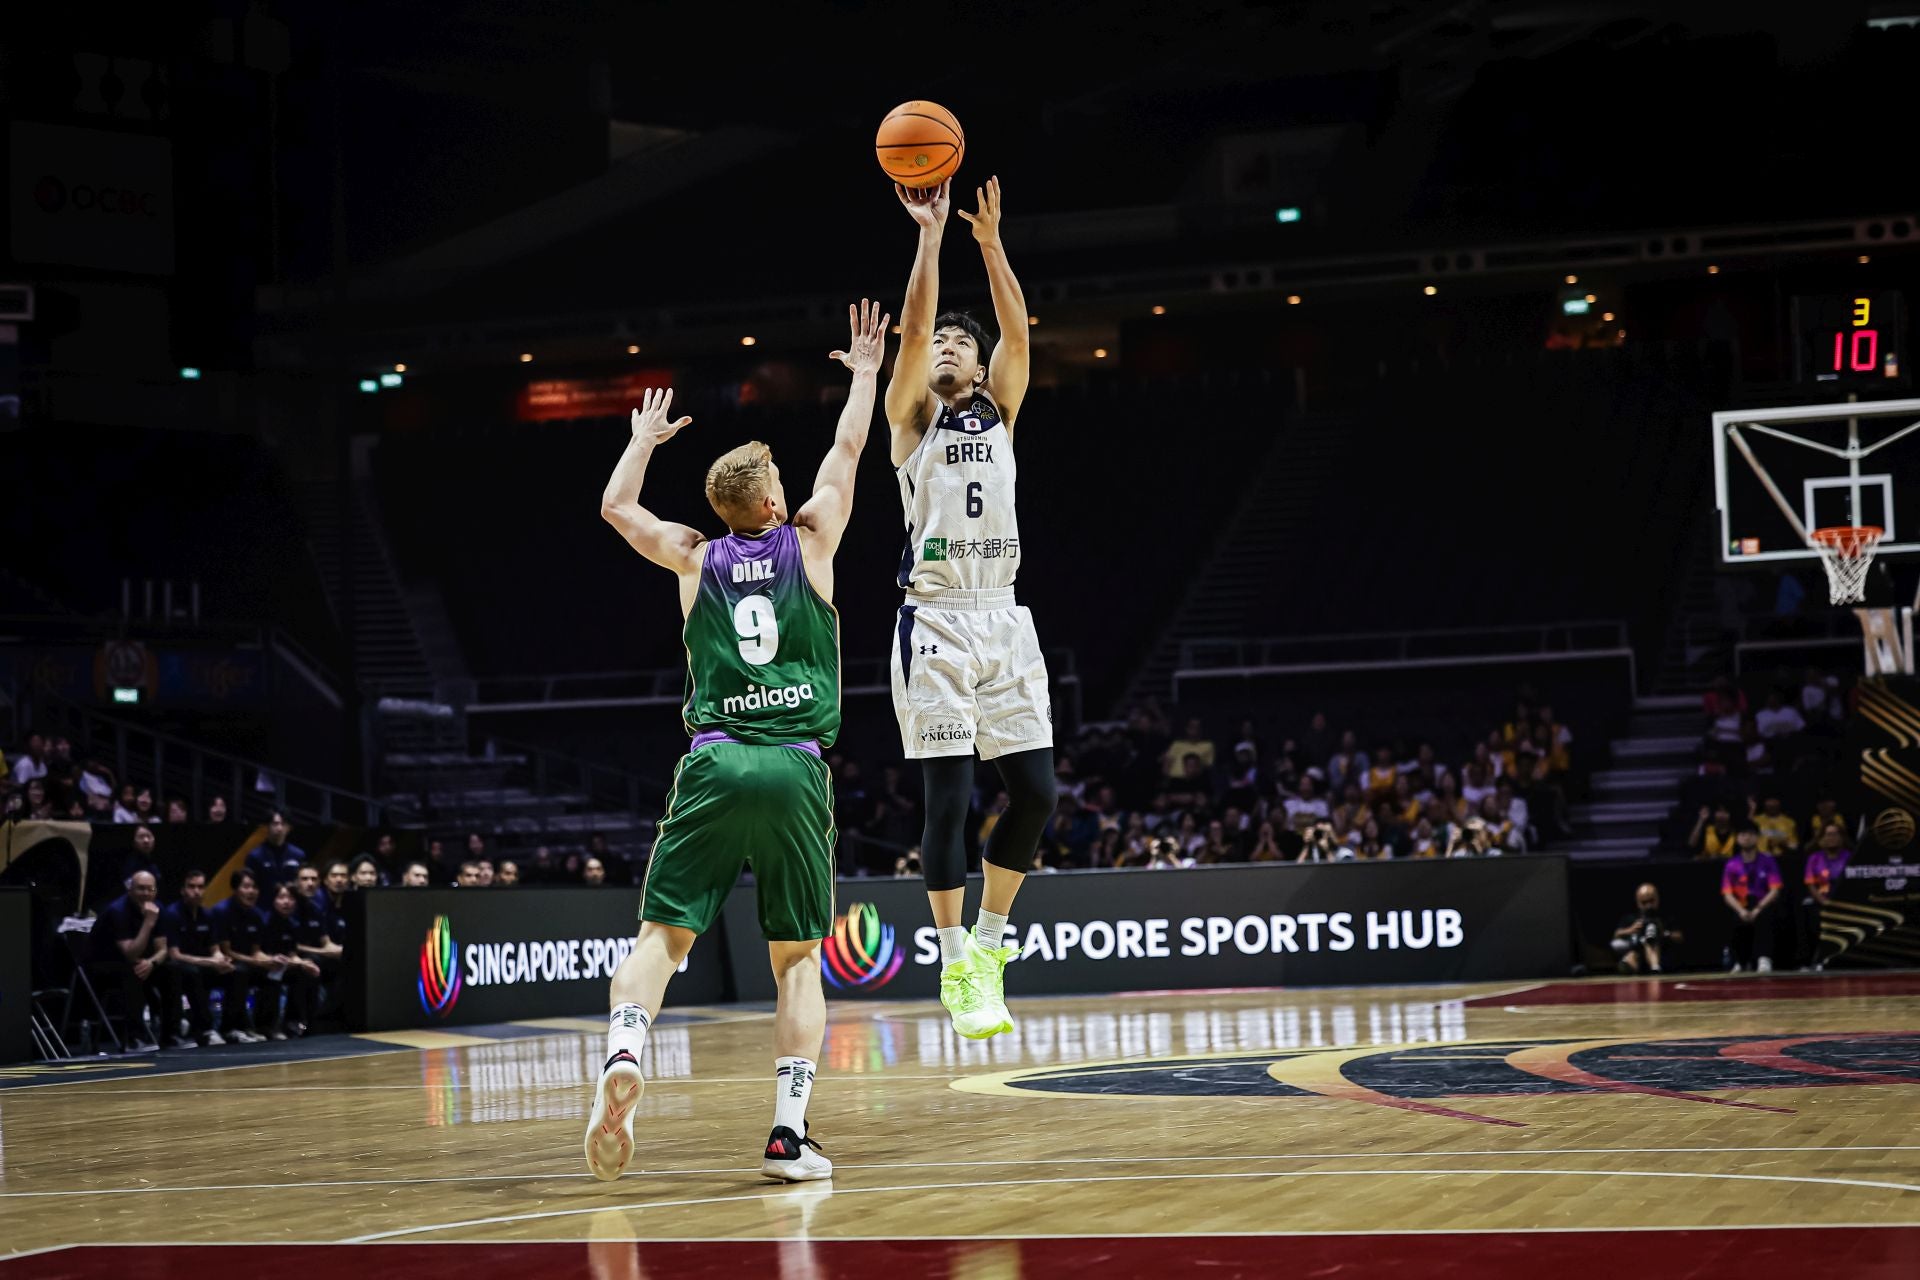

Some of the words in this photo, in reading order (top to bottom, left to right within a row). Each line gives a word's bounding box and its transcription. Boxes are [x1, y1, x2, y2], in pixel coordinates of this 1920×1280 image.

[1852, 298, 1870, 326] 3
[1834, 330, 1878, 371] 10
[946, 443, 993, 465] BREX
[966, 482, 983, 518] 6
[948, 539, 1018, 560] 栃木銀行
[733, 594, 779, 666] 9
[724, 684, 814, 714] málaga
[929, 730, 972, 741] NICIGAS
[1180, 912, 1355, 956] SPORTS
[1366, 909, 1464, 950] HUB
[465, 940, 580, 986] SINGAPORE
